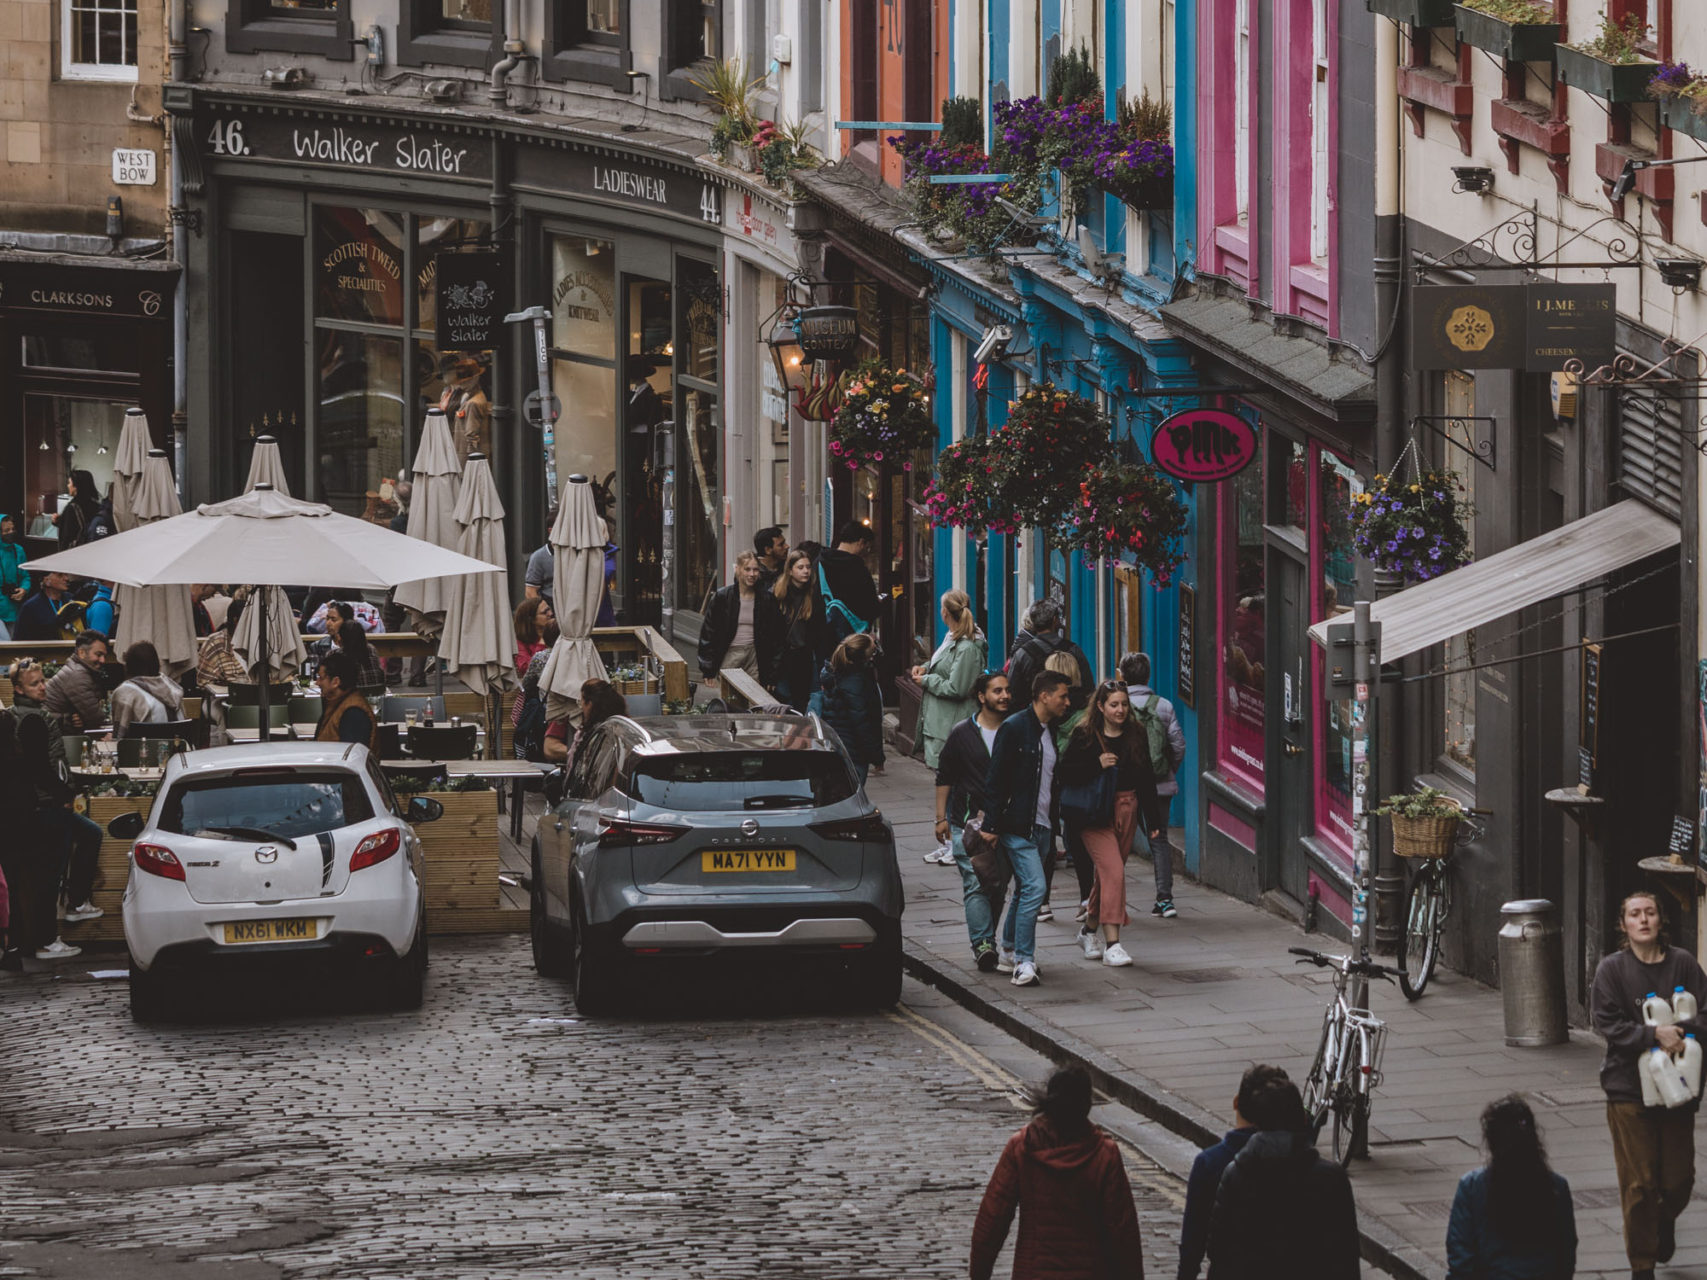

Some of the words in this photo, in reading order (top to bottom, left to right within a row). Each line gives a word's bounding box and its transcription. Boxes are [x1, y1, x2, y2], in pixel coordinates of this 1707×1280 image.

[293, 127, 378, 164] Walker
[396, 134, 466, 173] Slater
[117, 152, 151, 166] WEST
[119, 167, 149, 181] BOW
[594, 166, 666, 203] LADIESWEAR
[323, 241, 368, 272] SCOTTISH
[371, 245, 400, 280] TWEED
[358, 261, 366, 273] &
[338, 275, 386, 293] SPECIALITIES
[31, 290, 113, 307] CLARKSONS
[448, 314, 491, 326] Walker
[568, 304, 600, 322] KNITWEAR
[801, 319, 856, 334] MUSEUM
[451, 329, 489, 342] Slater
[713, 852, 749, 869] MA71
[754, 851, 786, 868] YYN
[234, 923, 270, 939] NX61
[275, 920, 307, 937] WKM
